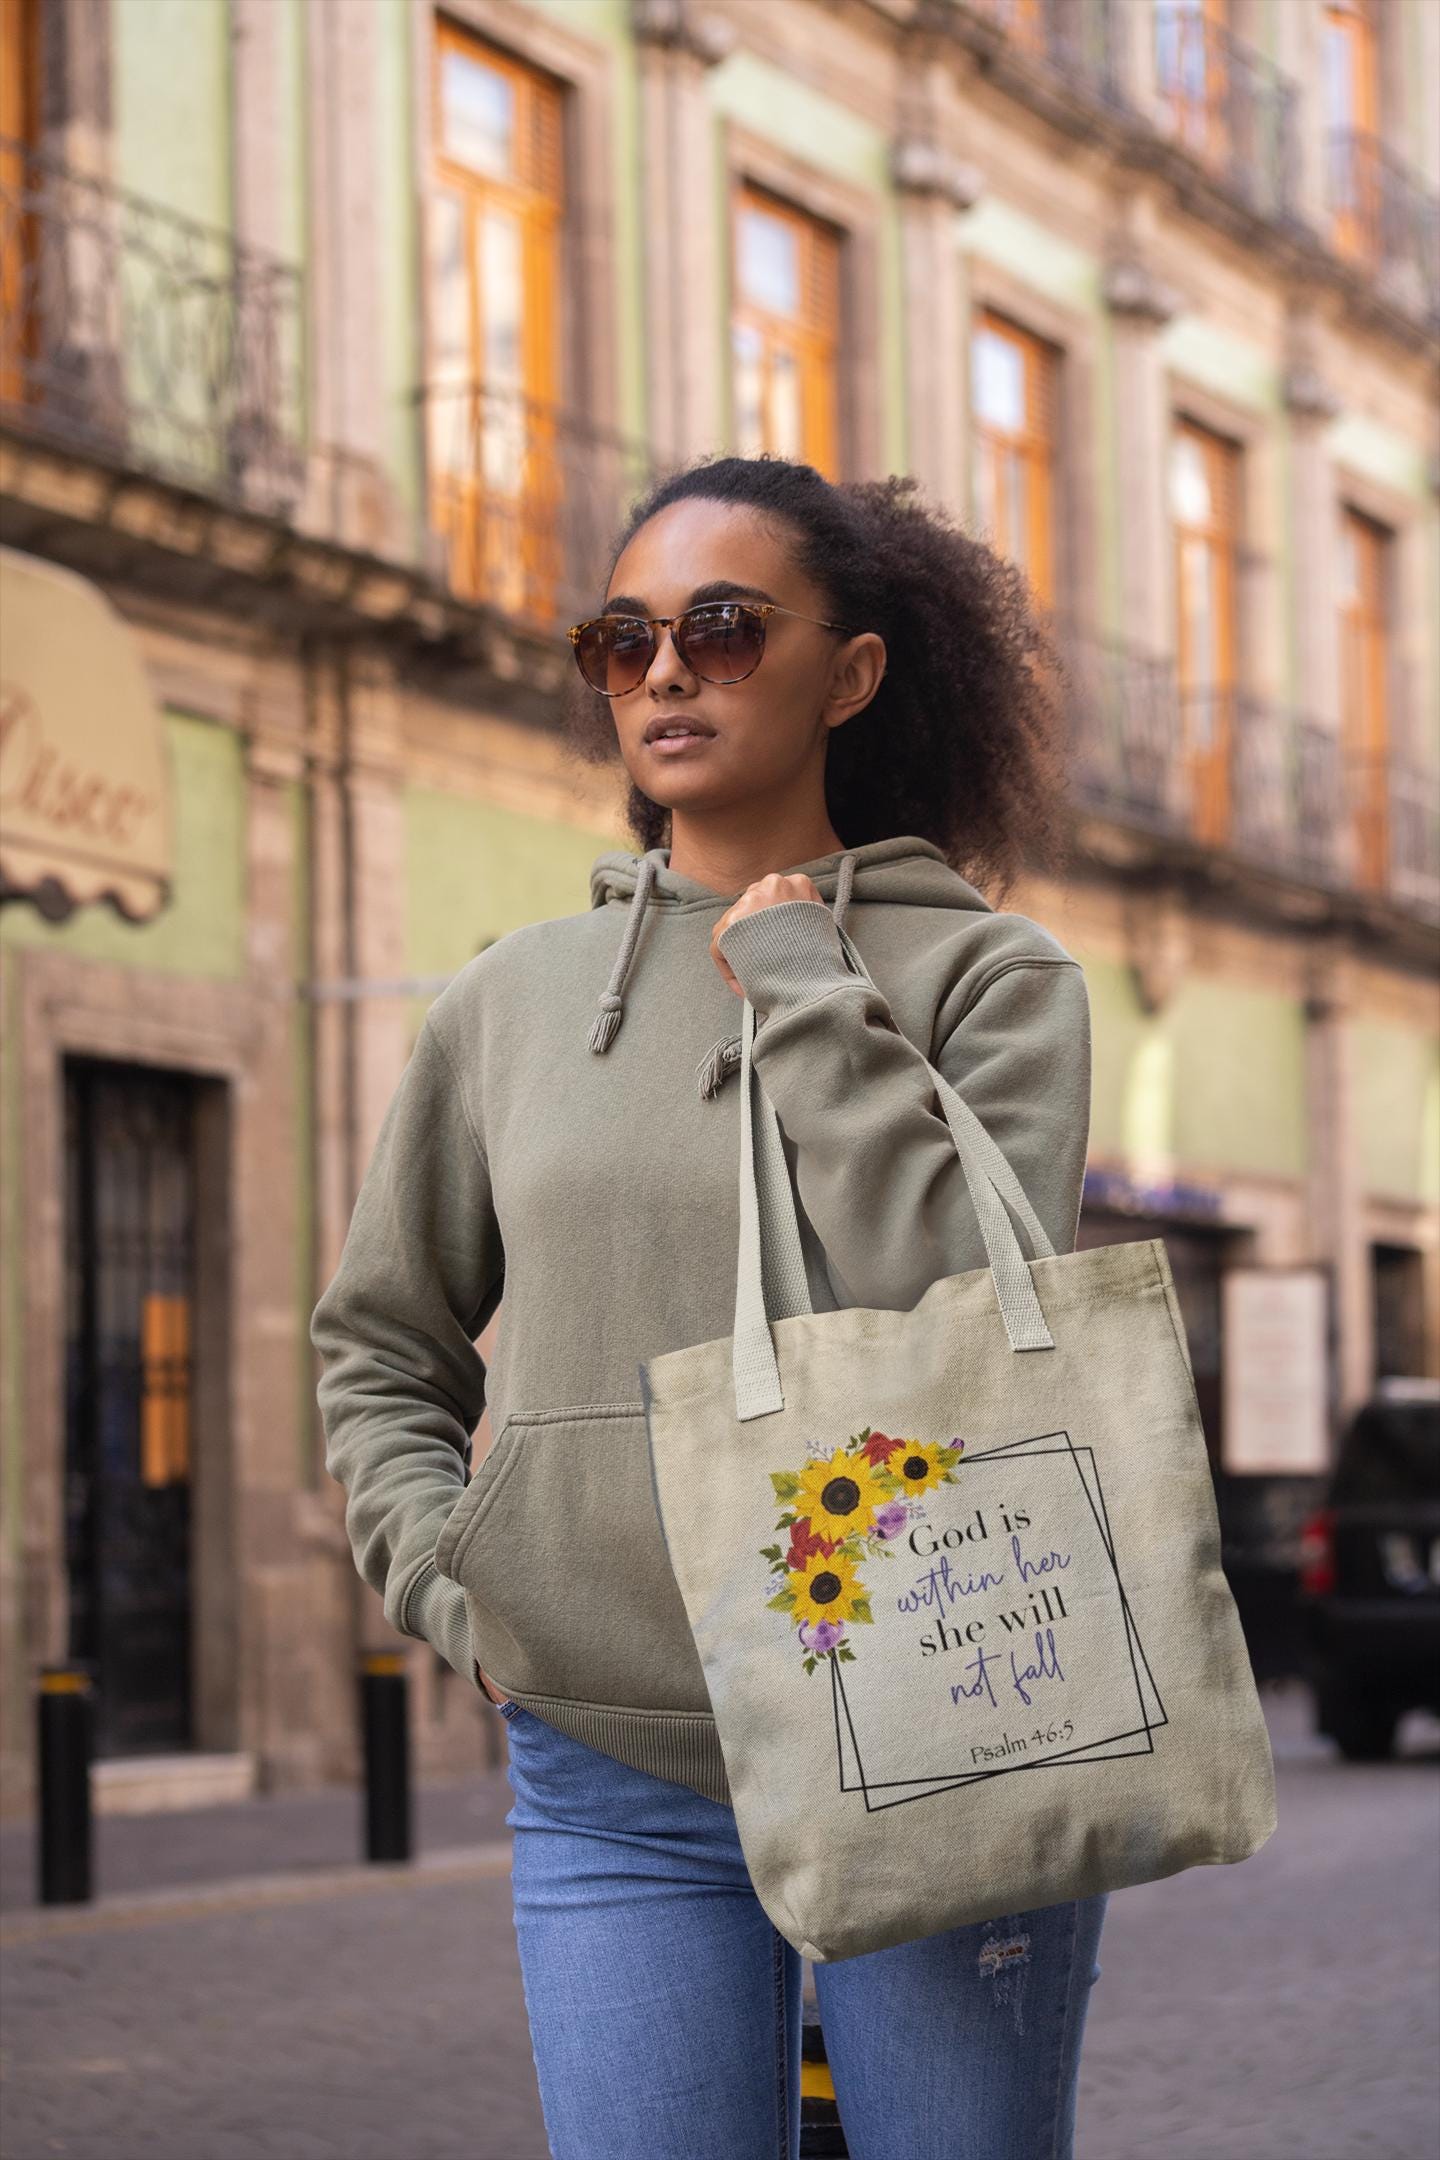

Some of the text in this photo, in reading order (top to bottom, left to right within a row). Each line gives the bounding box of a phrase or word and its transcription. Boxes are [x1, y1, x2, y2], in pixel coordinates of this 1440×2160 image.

[908, 1503, 1031, 1558] God is
[897, 1535, 1071, 1618] within her
[919, 1586, 1069, 1657] she will
[950, 1629, 1066, 1707] not fall
[970, 1720, 1075, 1764] Psalm 46:5
